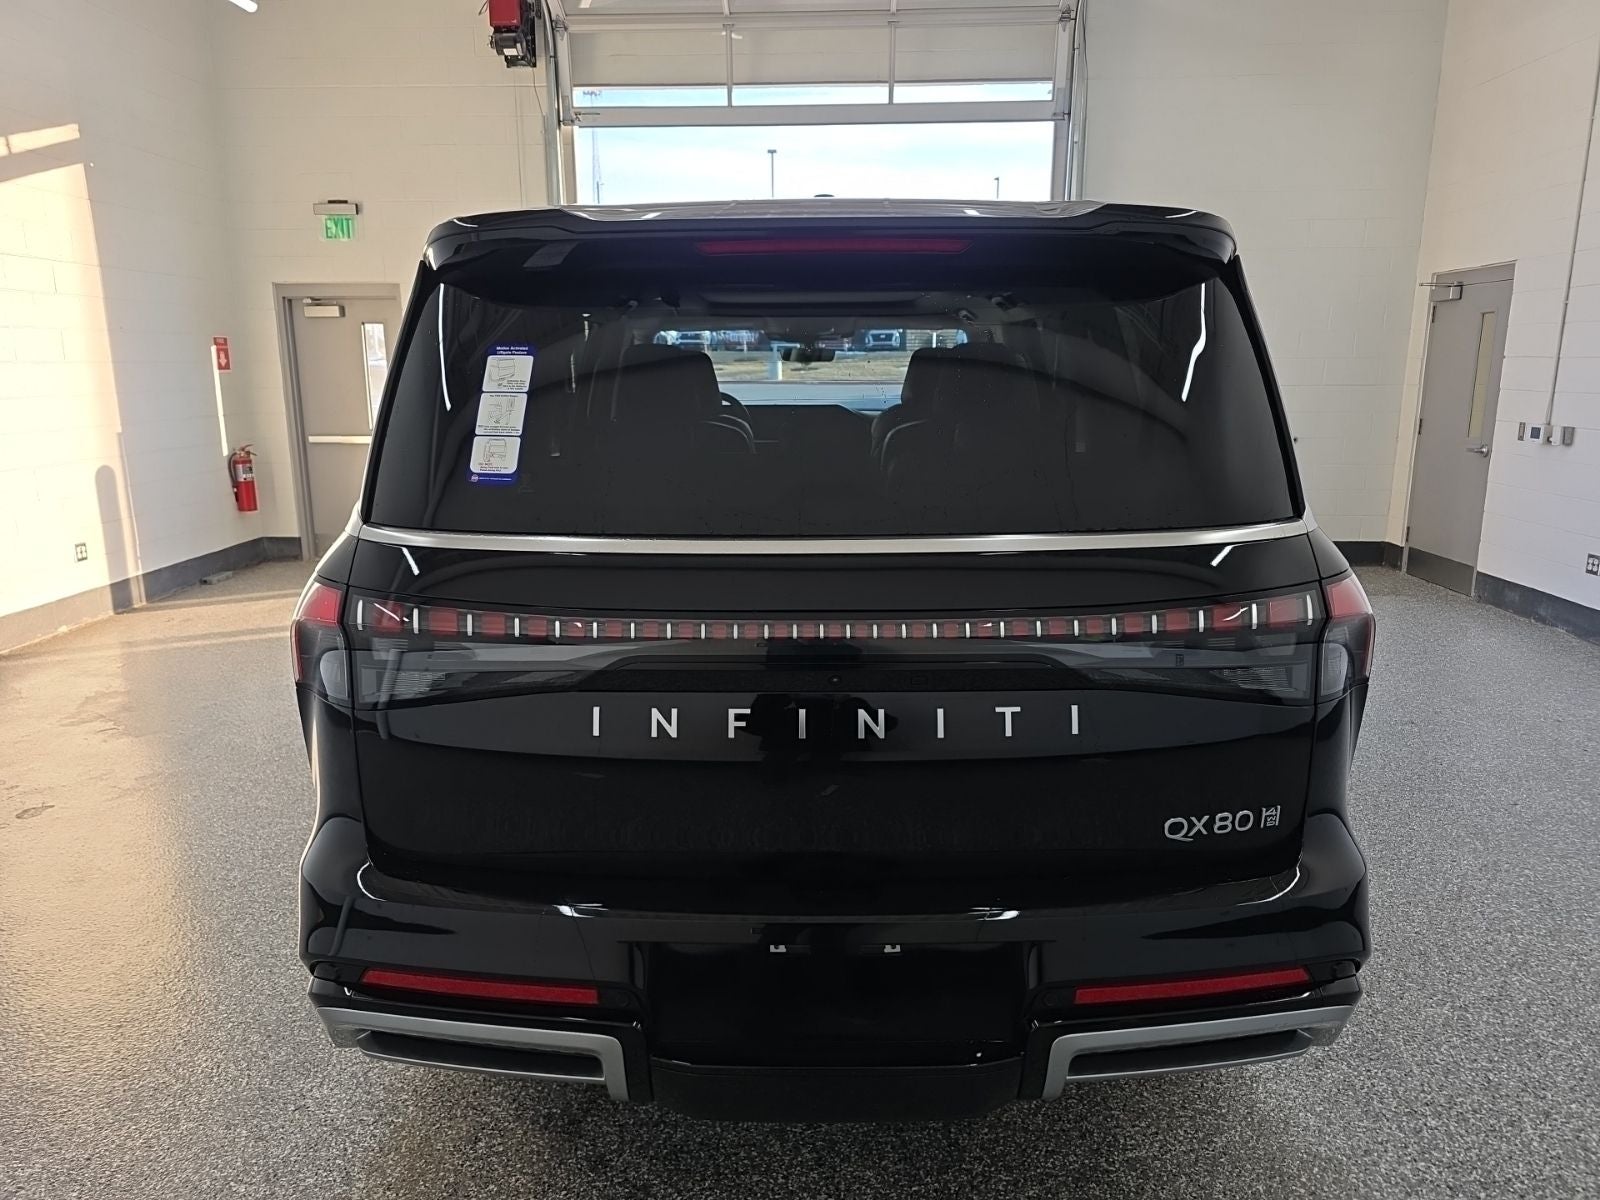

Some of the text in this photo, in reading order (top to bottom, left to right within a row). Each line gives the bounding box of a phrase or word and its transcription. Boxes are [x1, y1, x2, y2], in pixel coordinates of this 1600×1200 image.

[325, 217, 352, 239] EXIT
[592, 704, 1079, 738] INFINITI
[1164, 810, 1254, 842] QX80
